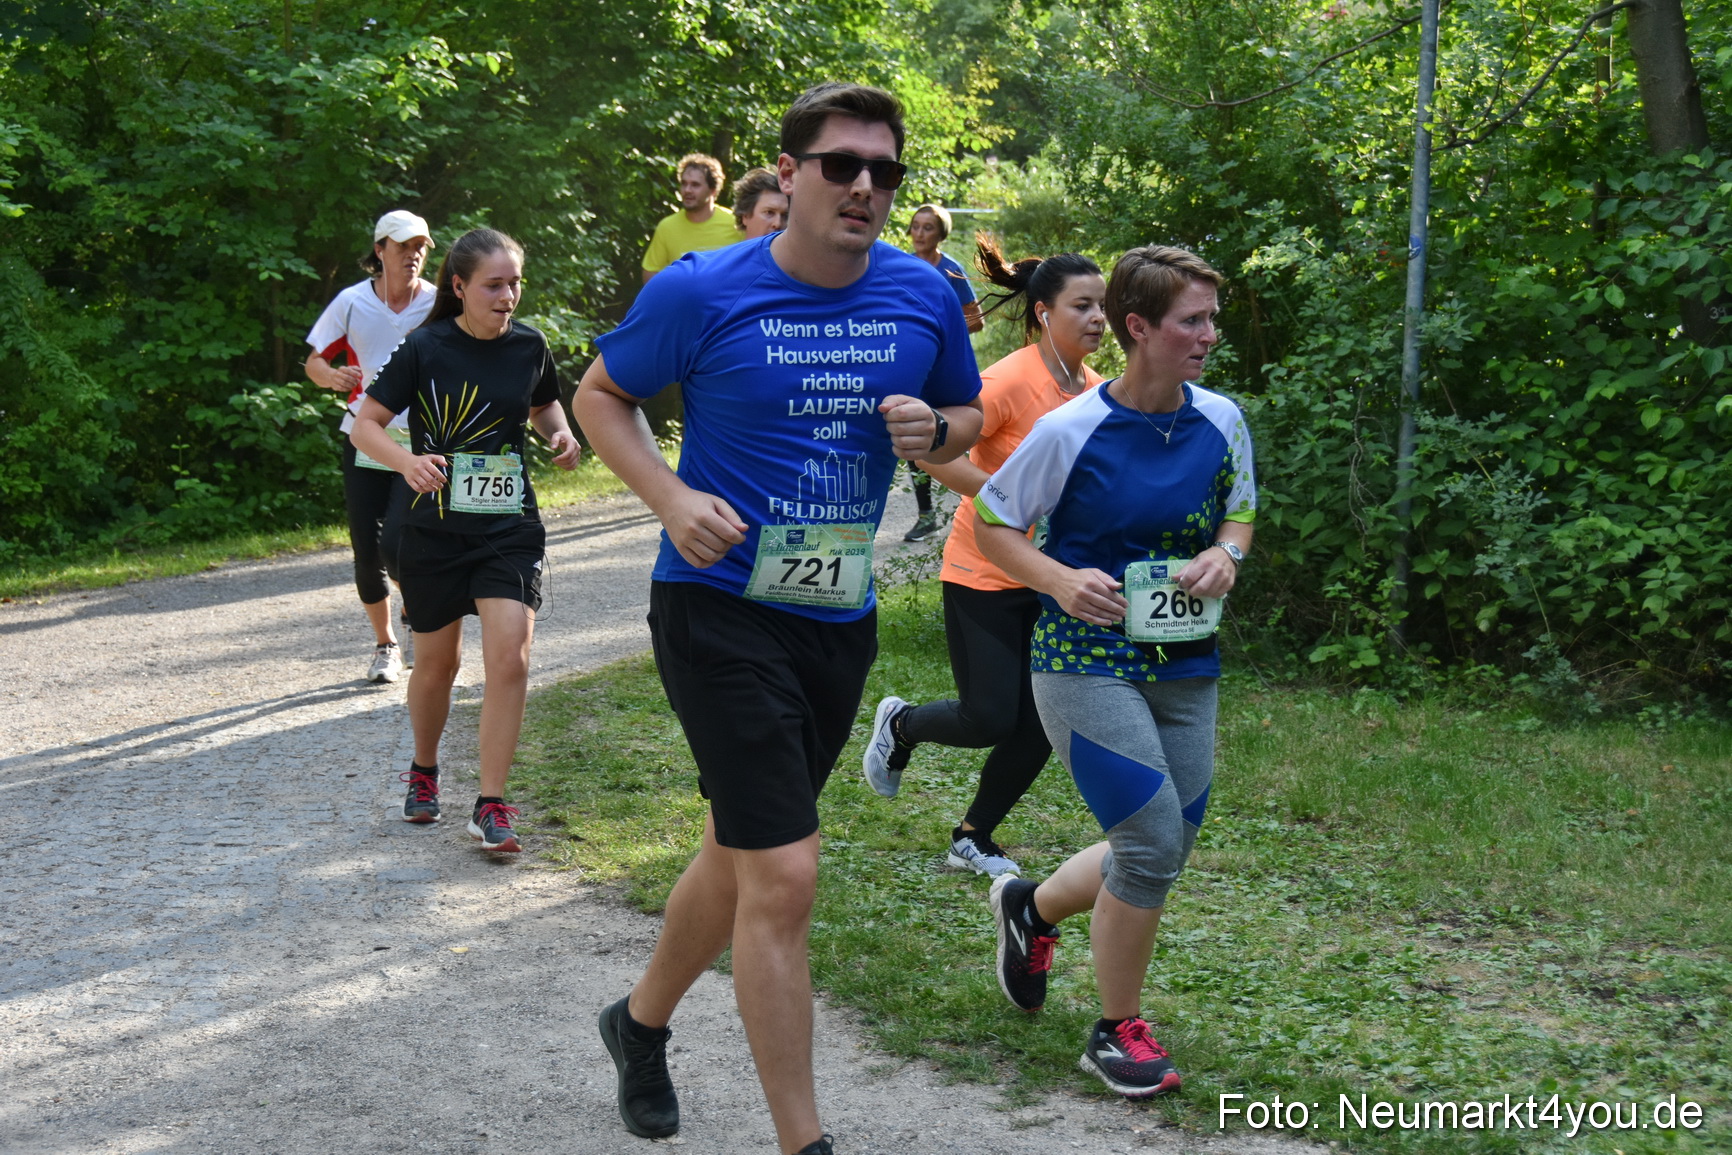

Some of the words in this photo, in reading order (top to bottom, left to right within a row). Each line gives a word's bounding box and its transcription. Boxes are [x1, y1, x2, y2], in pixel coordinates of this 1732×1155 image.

[760, 318, 818, 338] Wenn
[824, 325, 843, 338] es
[848, 319, 897, 337] beim
[766, 343, 897, 364] Hausverkauf
[802, 372, 865, 392] richtig
[788, 397, 875, 417] LAUFEN
[813, 421, 847, 440] soll!
[463, 476, 514, 497] 1756
[768, 496, 878, 520] FELDBUSCH
[776, 542, 820, 551] firmenlauf
[845, 547, 866, 556] 2019
[780, 556, 841, 587] 721
[765, 590, 798, 598] Feldbusch
[767, 583, 812, 594] Bräunlein
[814, 587, 846, 596] Markus
[1149, 590, 1204, 619] 266
[1145, 620, 1189, 629] Schmidtner
[1190, 618, 1209, 626] Heike
